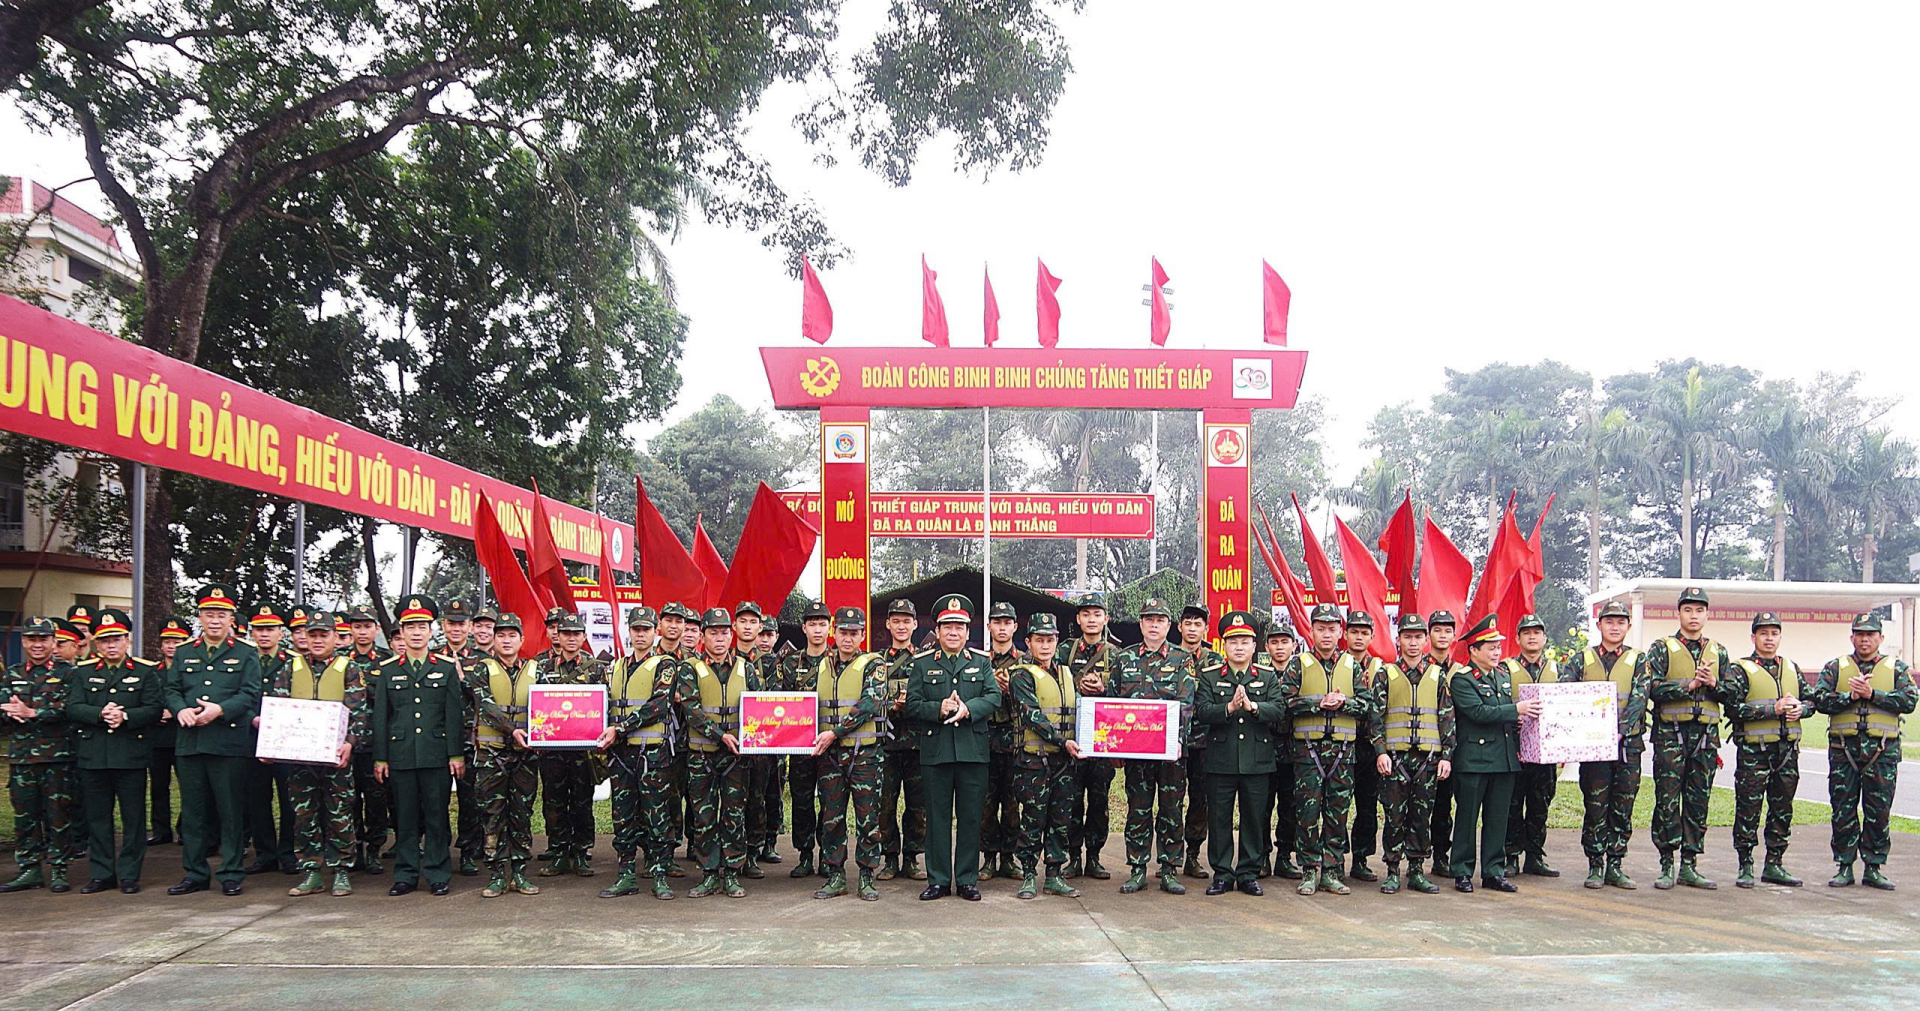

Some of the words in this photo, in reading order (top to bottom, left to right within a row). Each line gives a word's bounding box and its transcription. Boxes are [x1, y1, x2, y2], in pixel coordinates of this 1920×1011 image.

[861, 361, 904, 388] ĐOÀN
[908, 362, 950, 388] CÔNG
[953, 366, 990, 388] BINH
[995, 366, 1031, 388] BINH
[1035, 359, 1086, 389] CHỦNG
[1090, 363, 1129, 389] TĂNG
[1133, 361, 1174, 390] THIẾT
[1178, 364, 1213, 390] GIÁP
[112, 373, 178, 450] VỚI
[189, 391, 287, 485] ĐẢNG,
[295, 432, 353, 496] HIẾU
[358, 452, 393, 507] VỚI
[397, 464, 436, 517] DÂN
[439, 499, 447, 509] -
[450, 481, 472, 526] ĐÃ
[550, 512, 577, 552] ĐÁNH
[836, 491, 855, 523] MỞ
[871, 497, 906, 513] THIẾT
[910, 498, 940, 514] GIÁP
[944, 501, 985, 514] TRUNG
[990, 498, 1012, 514] VỚI
[1015, 497, 1055, 515] ĐẢNG,
[1059, 498, 1088, 515] HIẾU
[1091, 498, 1113, 515] VỚI
[1116, 498, 1144, 515] DÂN
[1219, 496, 1236, 522] ĐÃ
[873, 517, 891, 532] ĐÃ
[895, 519, 912, 532] RA
[915, 517, 952, 532] QUÂN
[955, 517, 972, 532] LÀ
[1014, 516, 1057, 532] THẮNG
[1219, 534, 1235, 557] RA
[826, 551, 865, 580] ĐƯỜNG
[1212, 565, 1242, 591] QUÂN
